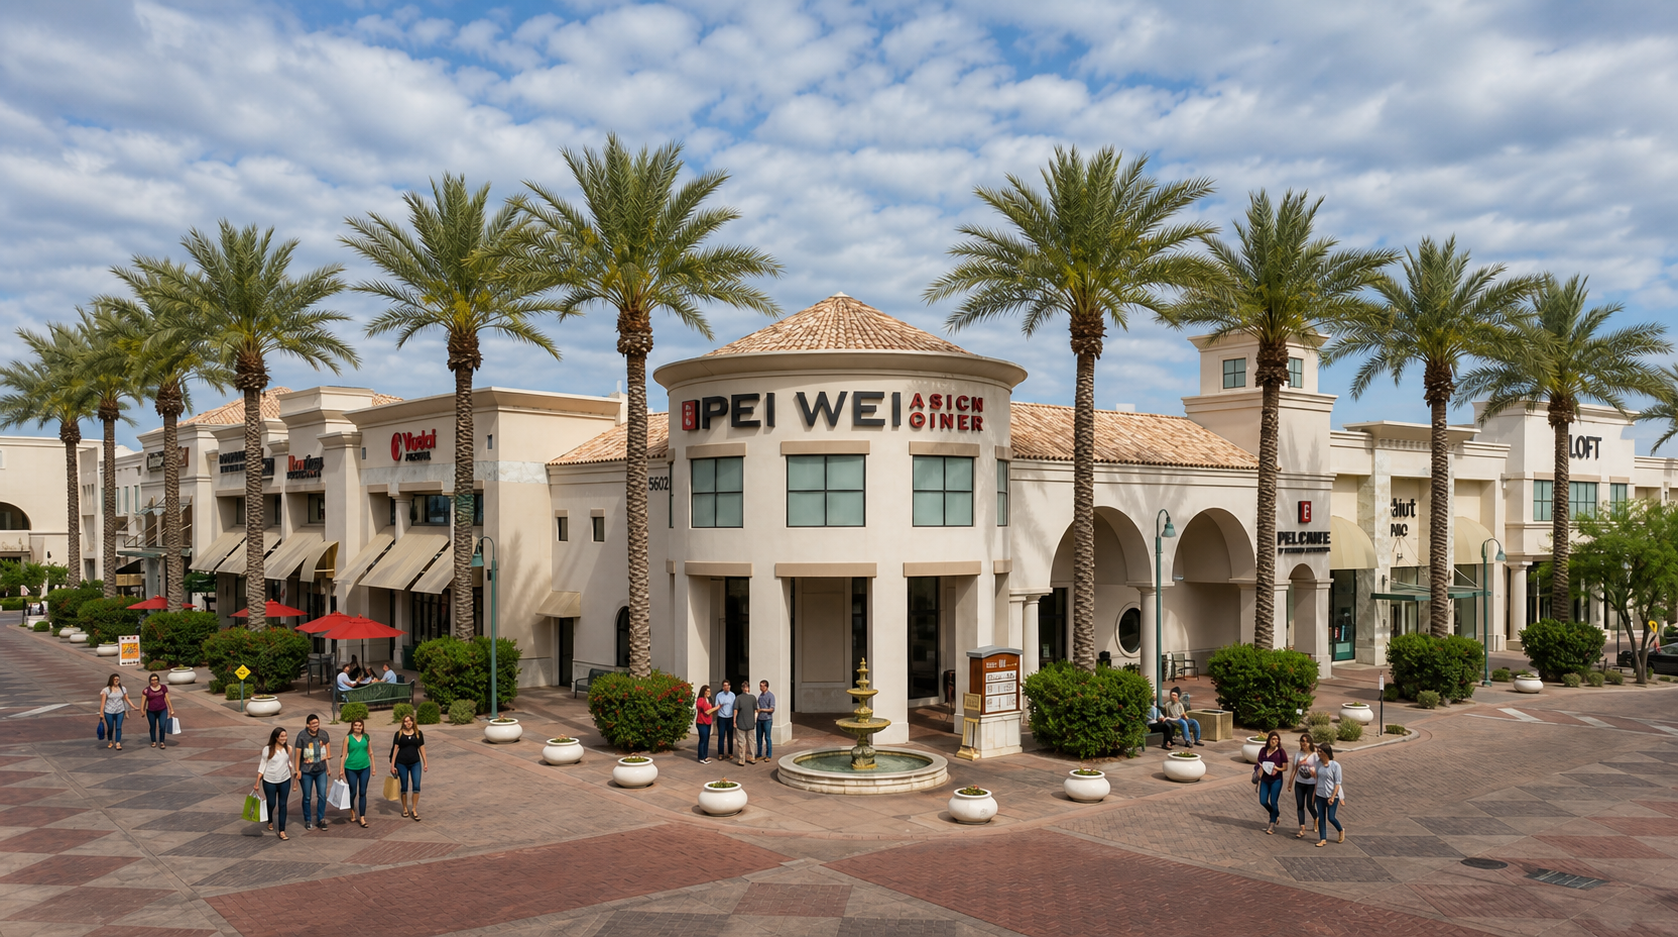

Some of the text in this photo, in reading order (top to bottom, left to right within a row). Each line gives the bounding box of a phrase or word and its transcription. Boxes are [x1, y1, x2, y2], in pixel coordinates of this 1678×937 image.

[702, 392, 776, 431] PEI
[796, 391, 902, 427] WEI
[1568, 434, 1602, 460] LOFT
[648, 476, 669, 491] 5602
